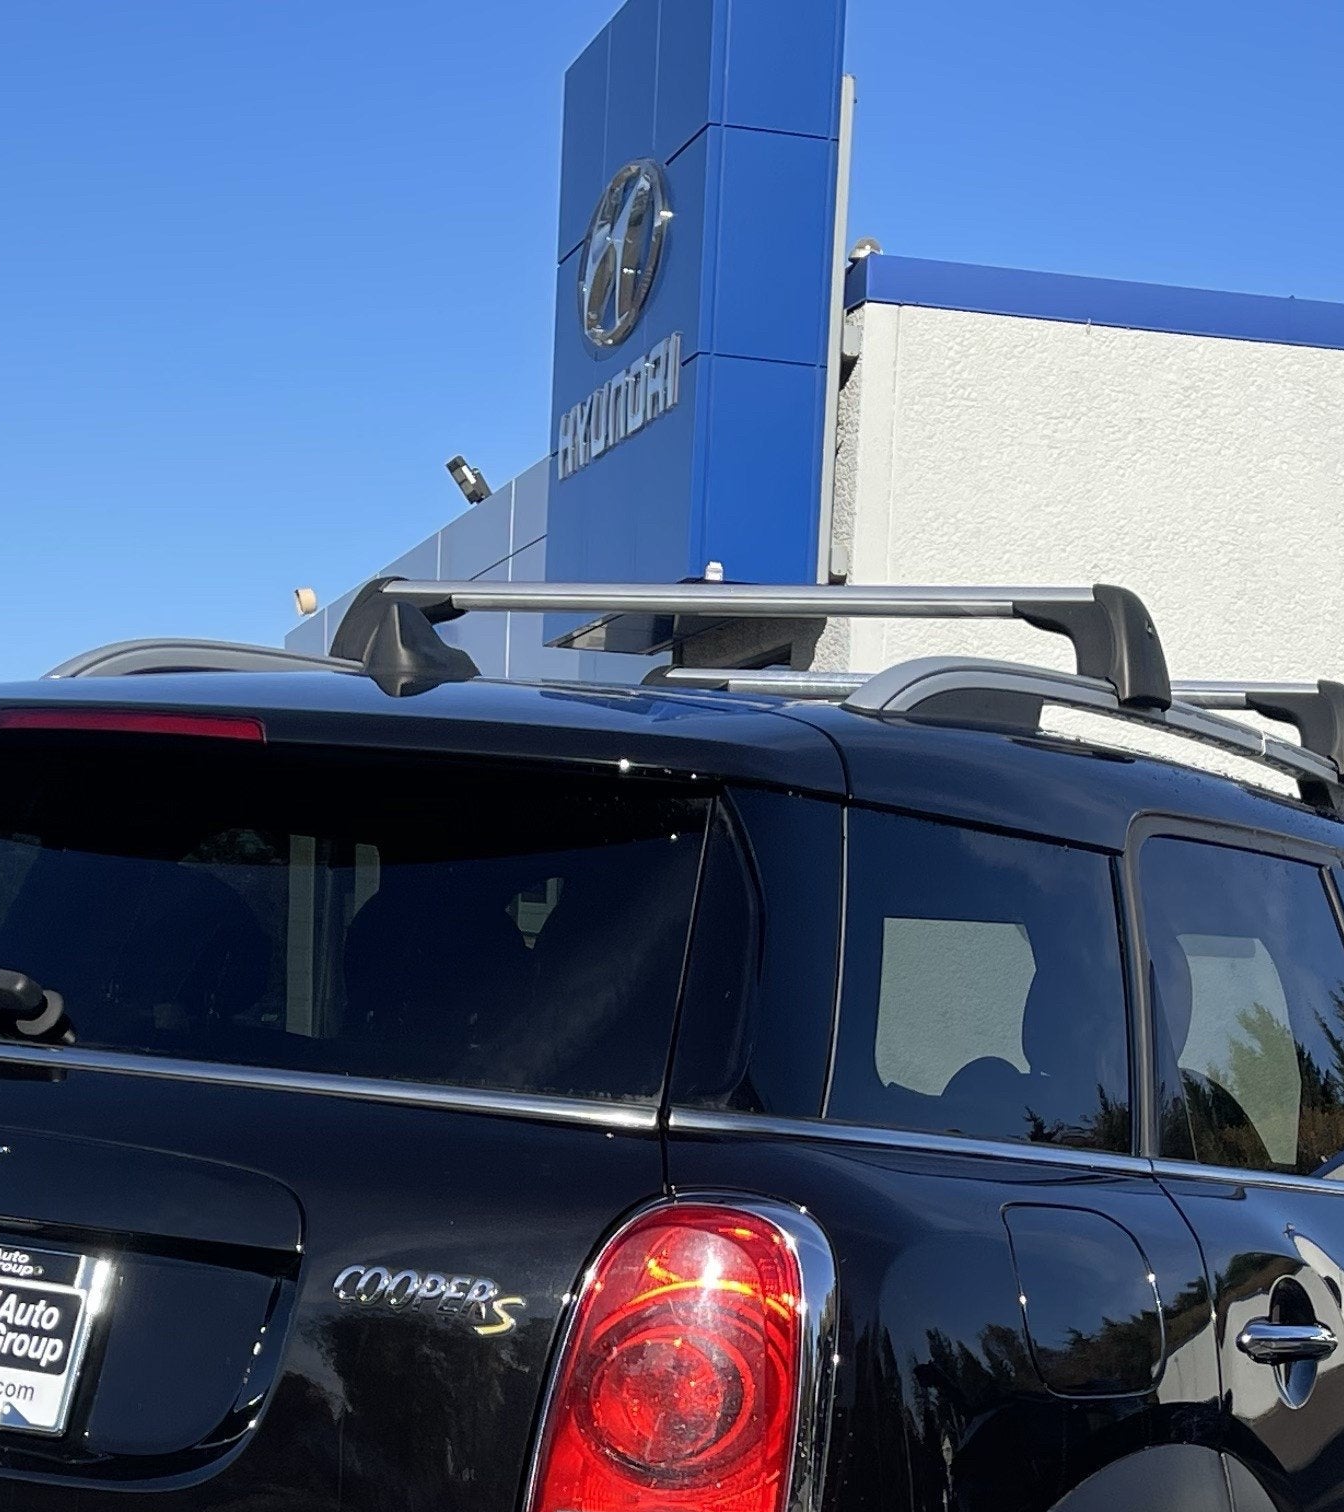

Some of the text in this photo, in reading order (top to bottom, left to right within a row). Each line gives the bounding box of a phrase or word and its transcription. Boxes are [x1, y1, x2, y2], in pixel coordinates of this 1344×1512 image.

[559, 331, 682, 481] HYUNDAI
[333, 1265, 527, 1336] COOPER S
